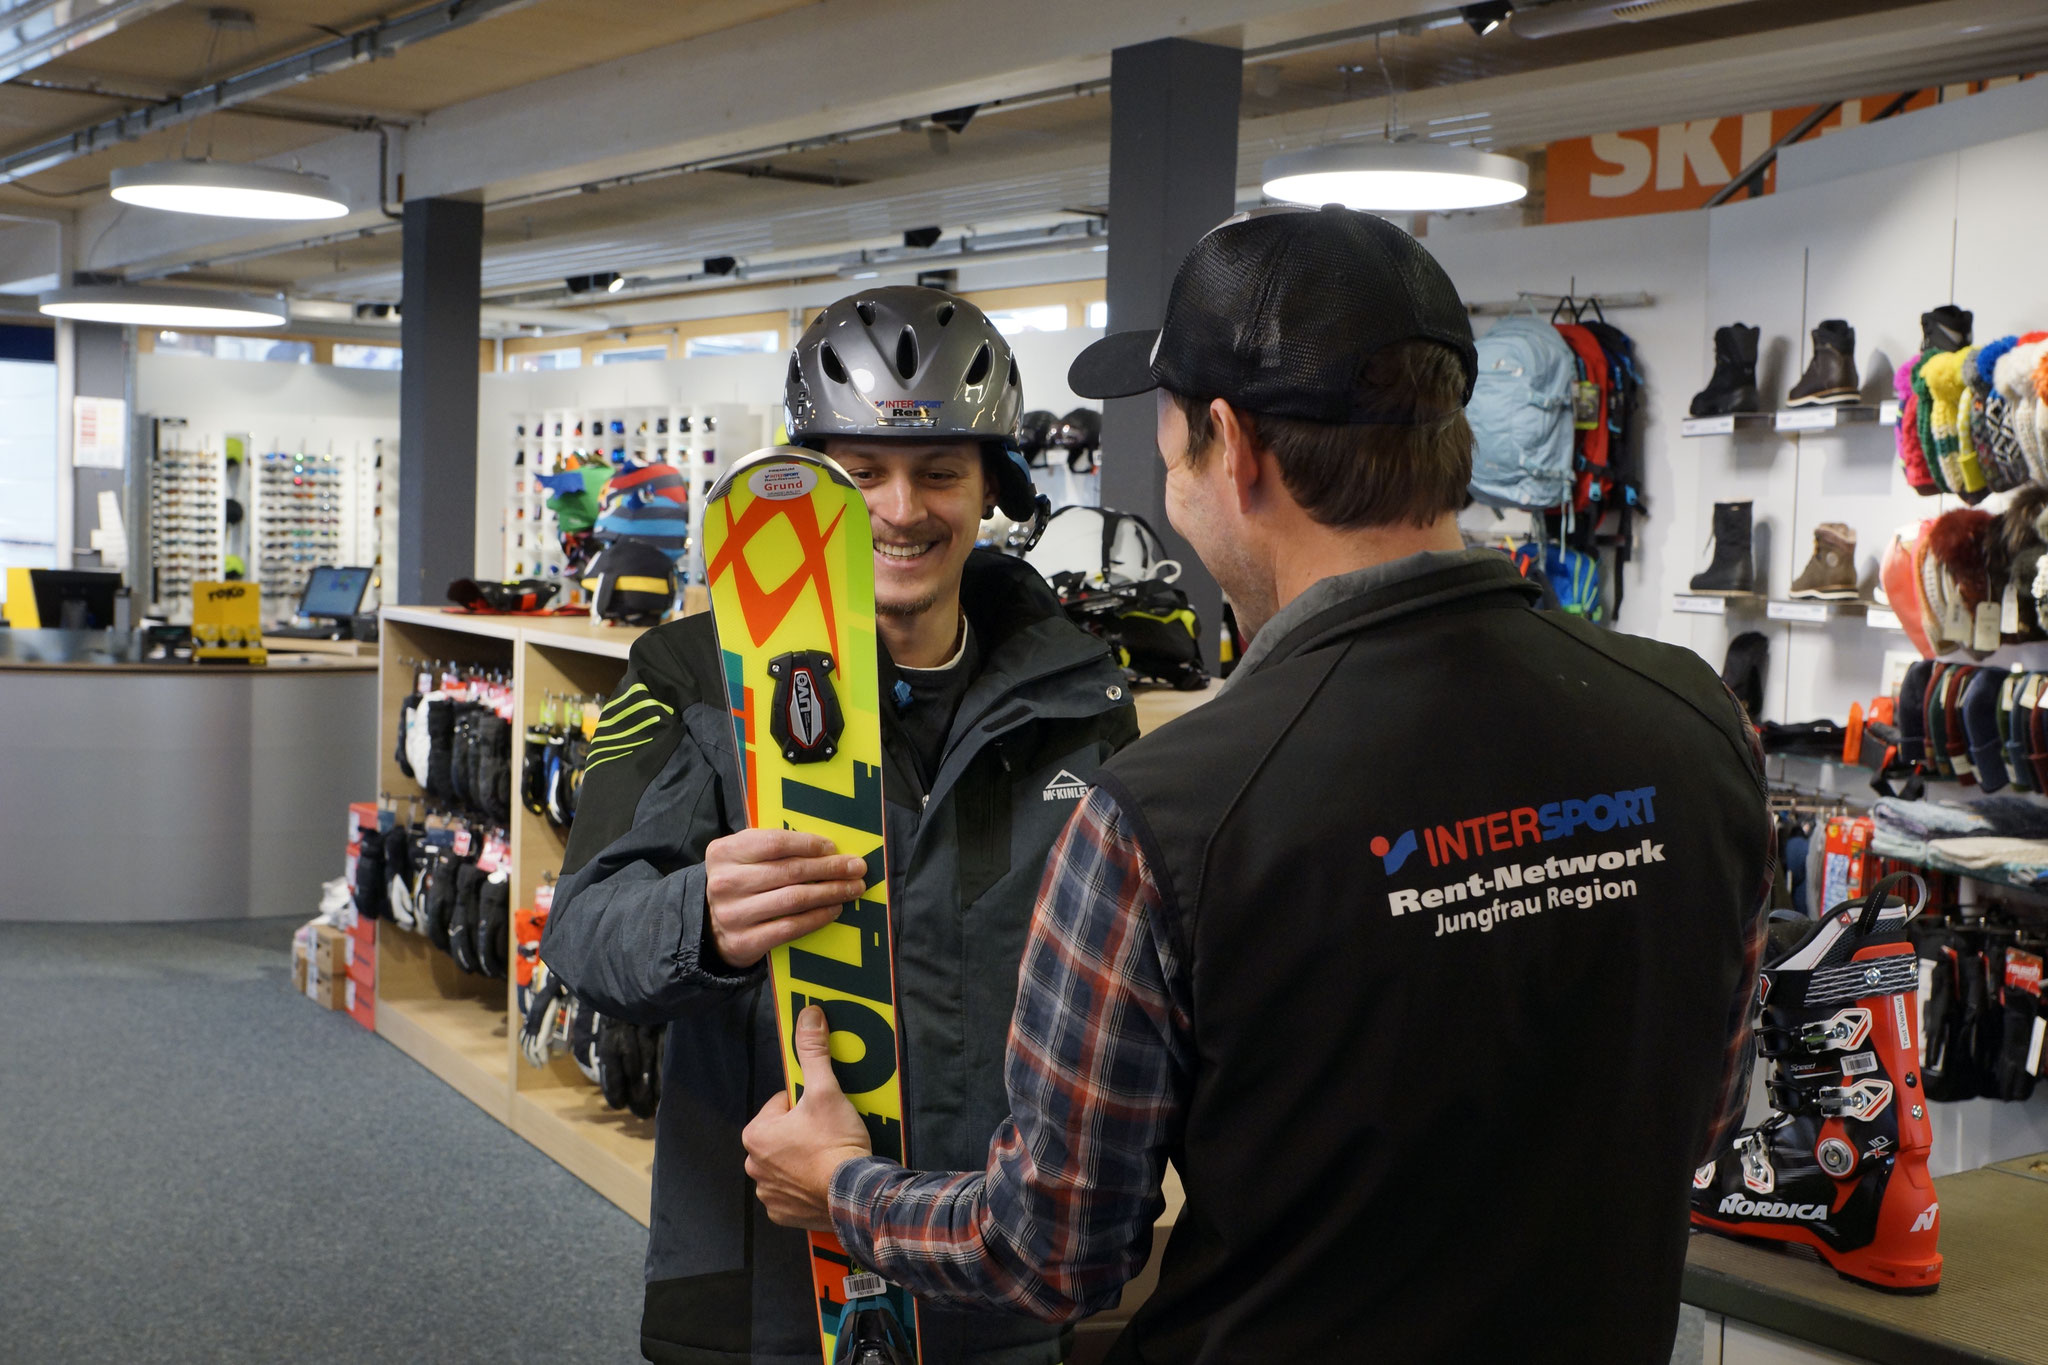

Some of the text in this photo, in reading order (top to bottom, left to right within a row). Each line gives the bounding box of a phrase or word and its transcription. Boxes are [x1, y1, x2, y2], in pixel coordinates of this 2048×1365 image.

[1589, 110, 1772, 198] SKI
[892, 408, 930, 417] Rent
[764, 480, 803, 491] Grund
[1424, 786, 1656, 867] INTERSPORT
[1387, 839, 1666, 916] Rent-Network
[1434, 878, 1638, 937] Jungfrau Region
[1790, 1062, 1816, 1073] Speed
[1718, 1193, 1828, 1220] NORDICA
